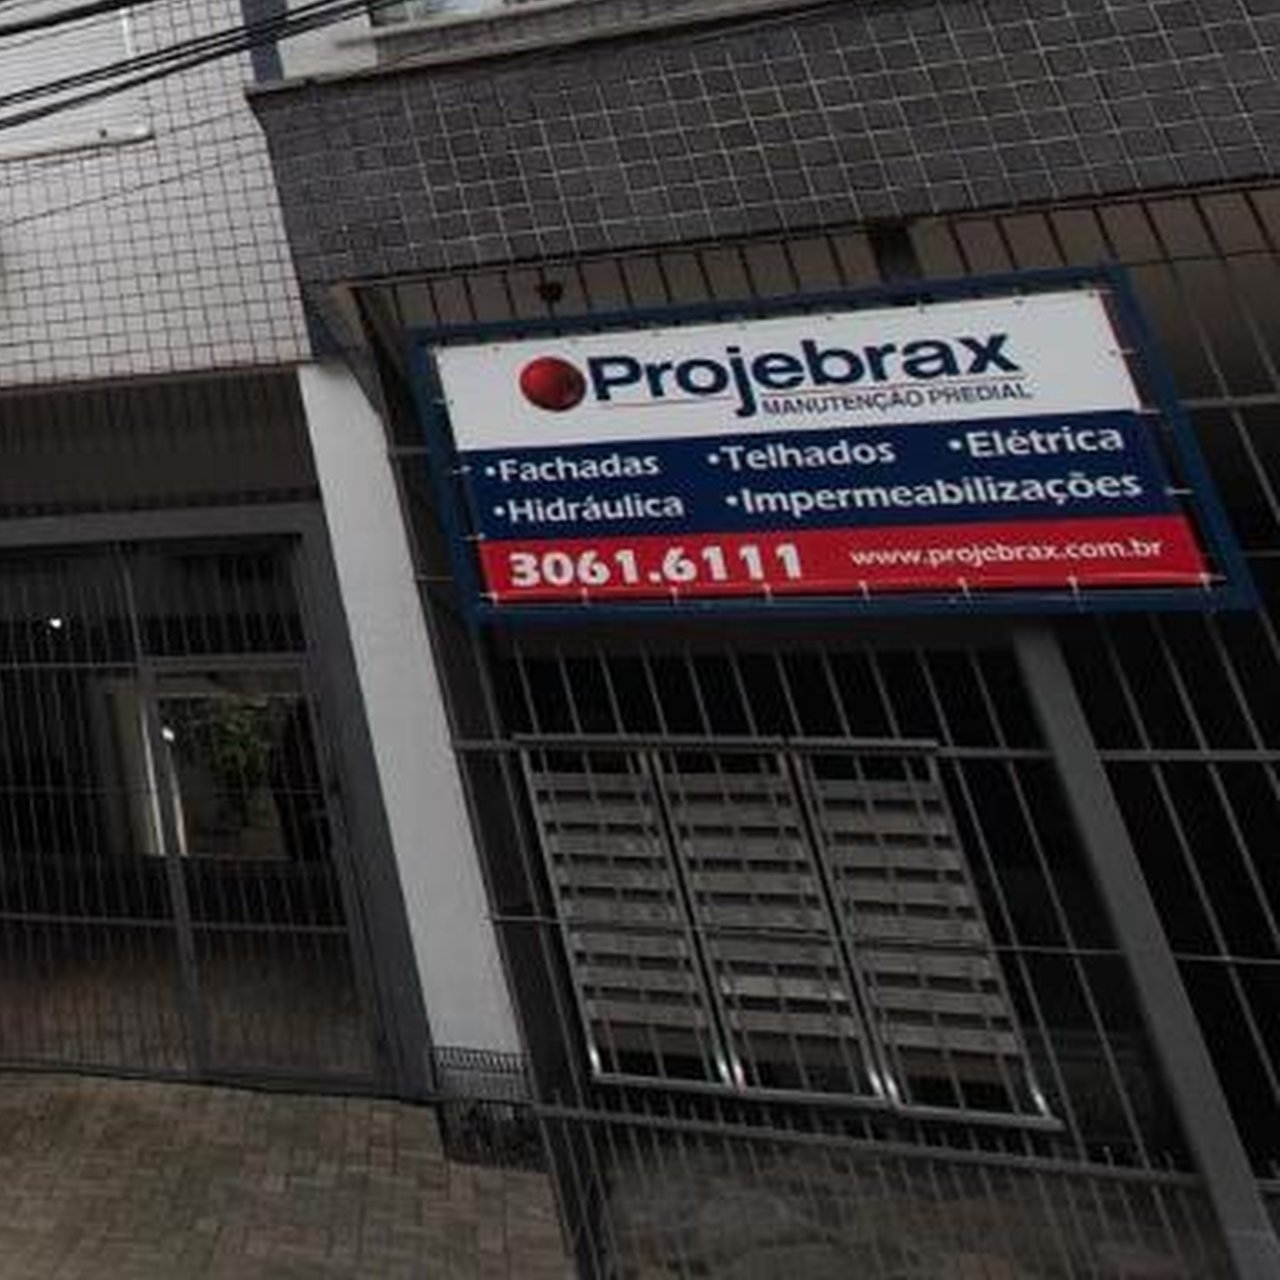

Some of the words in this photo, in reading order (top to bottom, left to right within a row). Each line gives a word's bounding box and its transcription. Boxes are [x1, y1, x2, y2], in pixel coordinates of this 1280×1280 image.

[587, 333, 1021, 418] Projebrax
[928, 382, 1031, 405] PREDIAL
[498, 453, 660, 483] Fachadas
[718, 438, 897, 472] Telhados
[966, 425, 1125, 458] Elétrica
[507, 492, 685, 523] Hidráulica
[740, 469, 1143, 519] Impermeabilizações
[508, 542, 803, 587] 3061.6111
[849, 536, 1163, 569] www.projebrax.com.br
